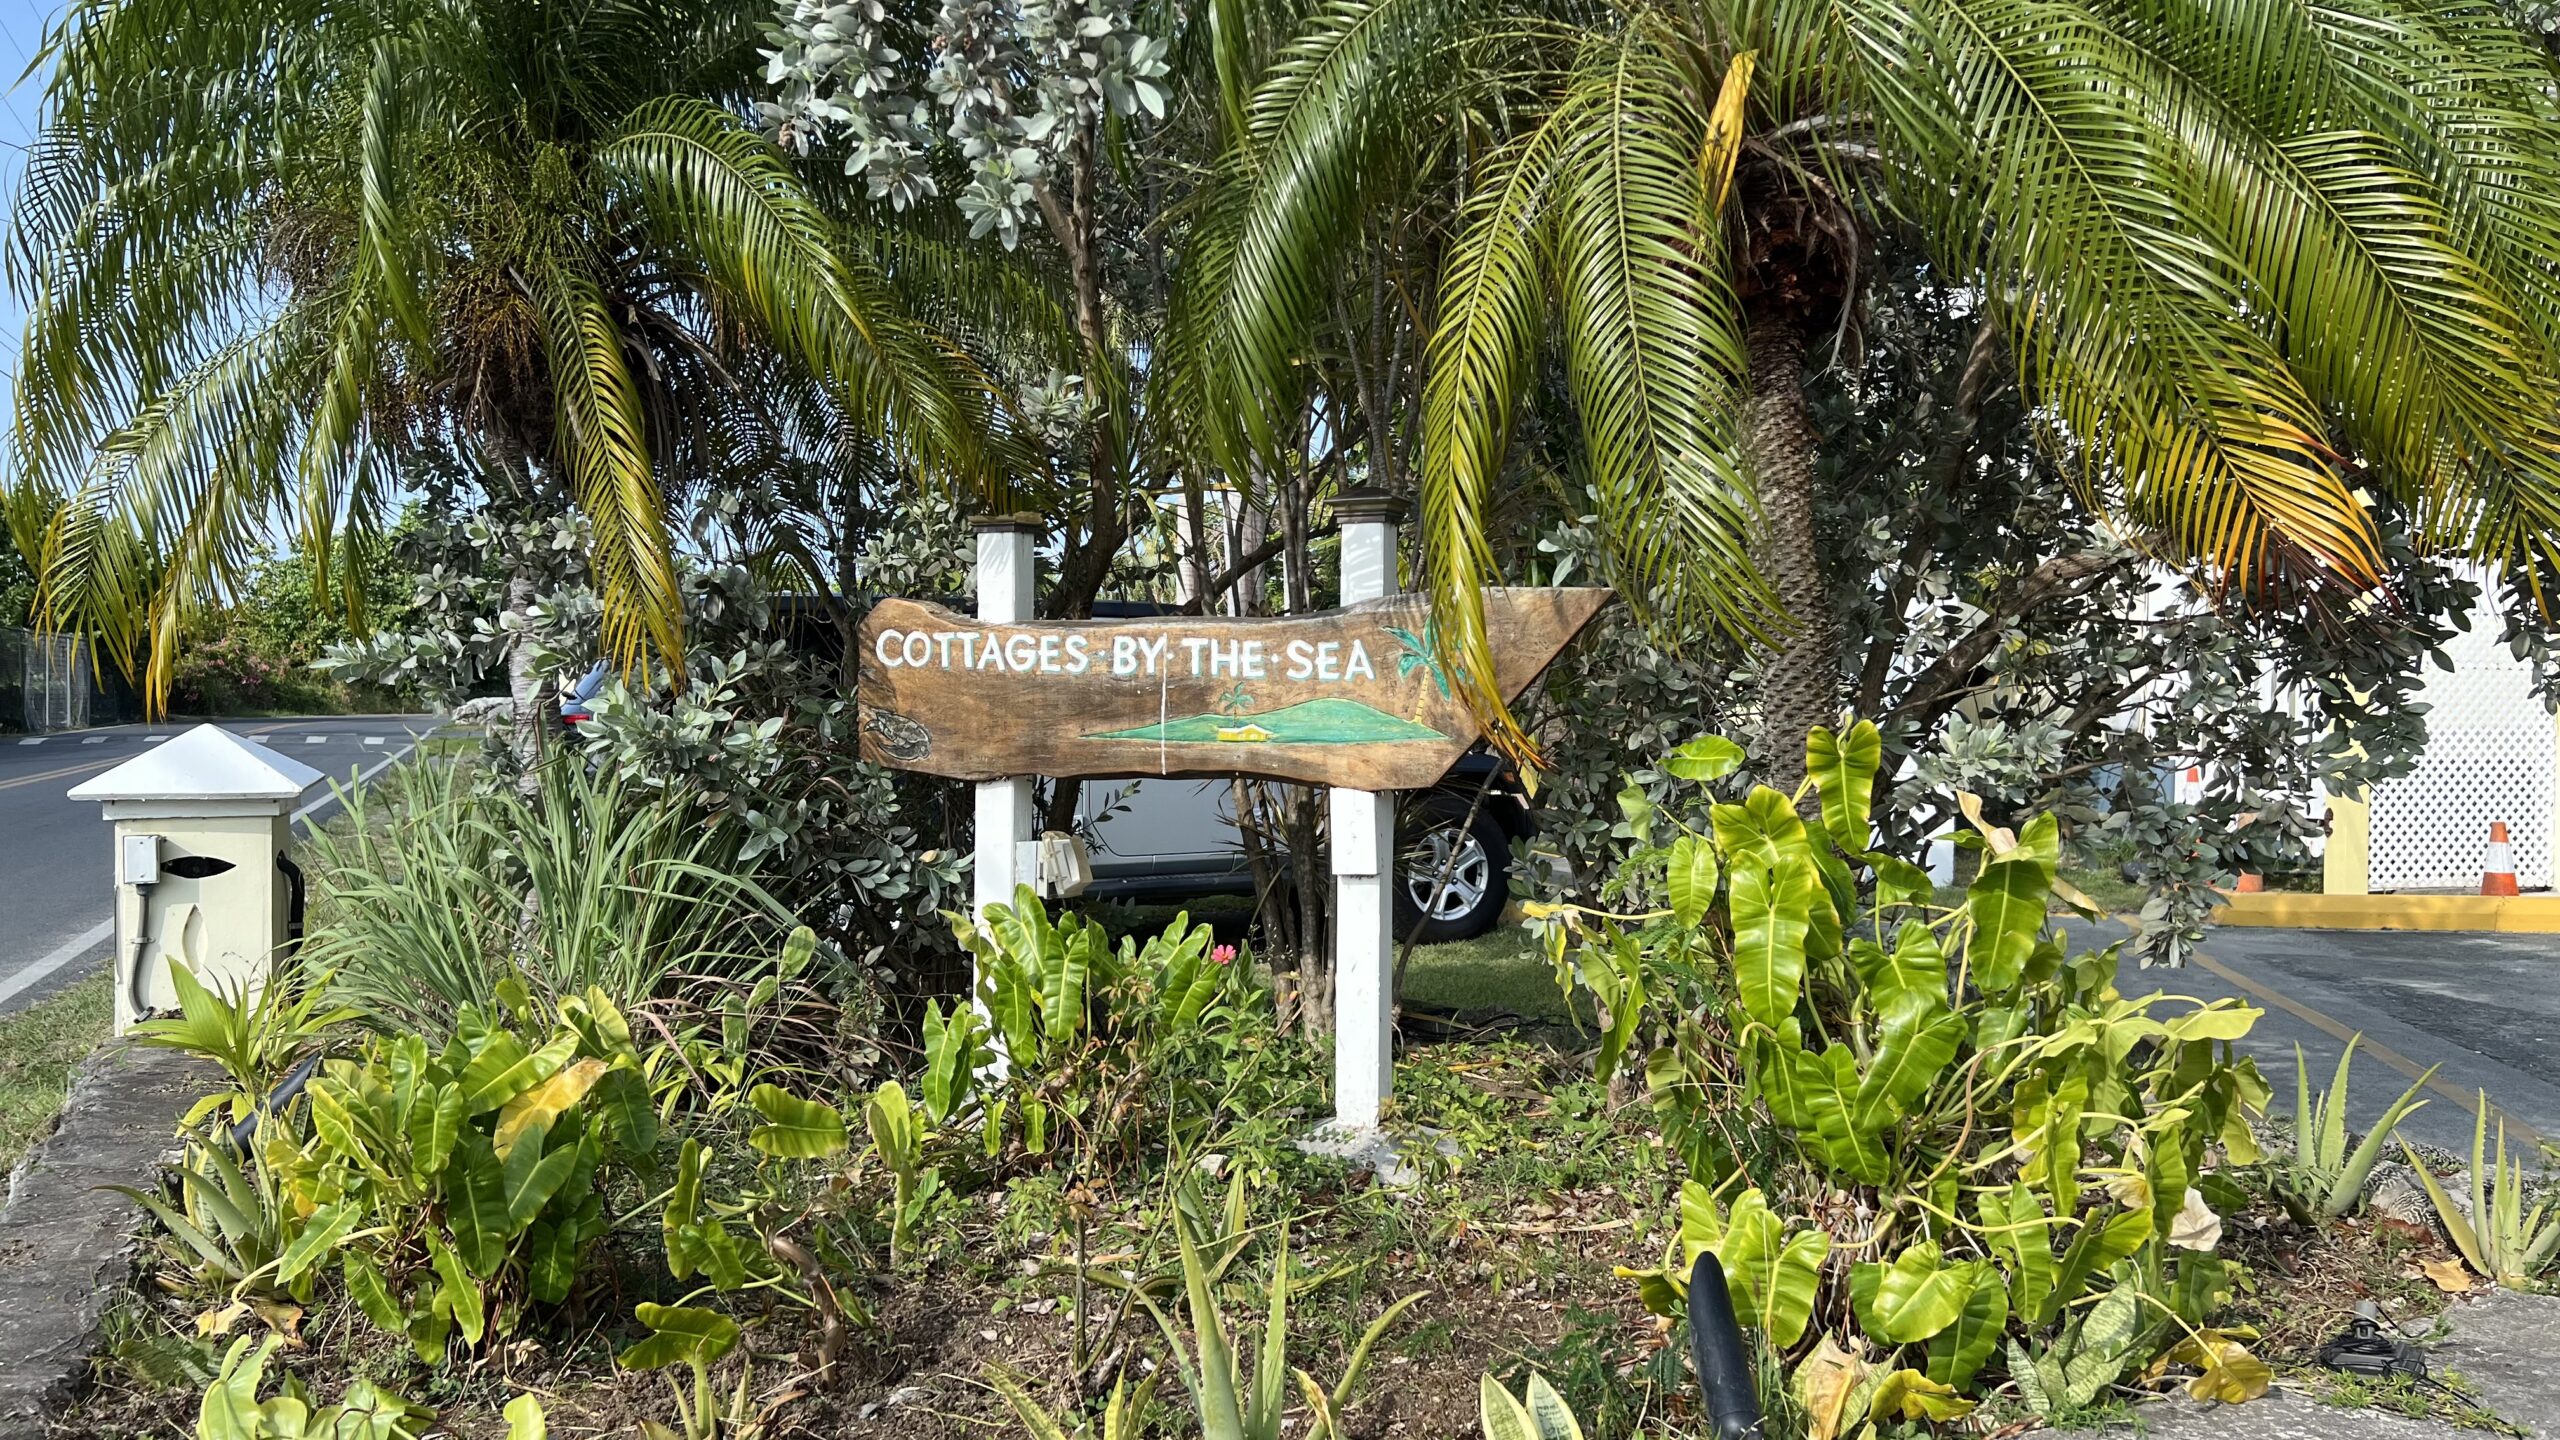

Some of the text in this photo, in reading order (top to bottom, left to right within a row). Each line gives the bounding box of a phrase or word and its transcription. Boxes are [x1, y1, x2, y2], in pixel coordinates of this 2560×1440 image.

[876, 629, 1376, 682] COTTAGES BY THE SEA
